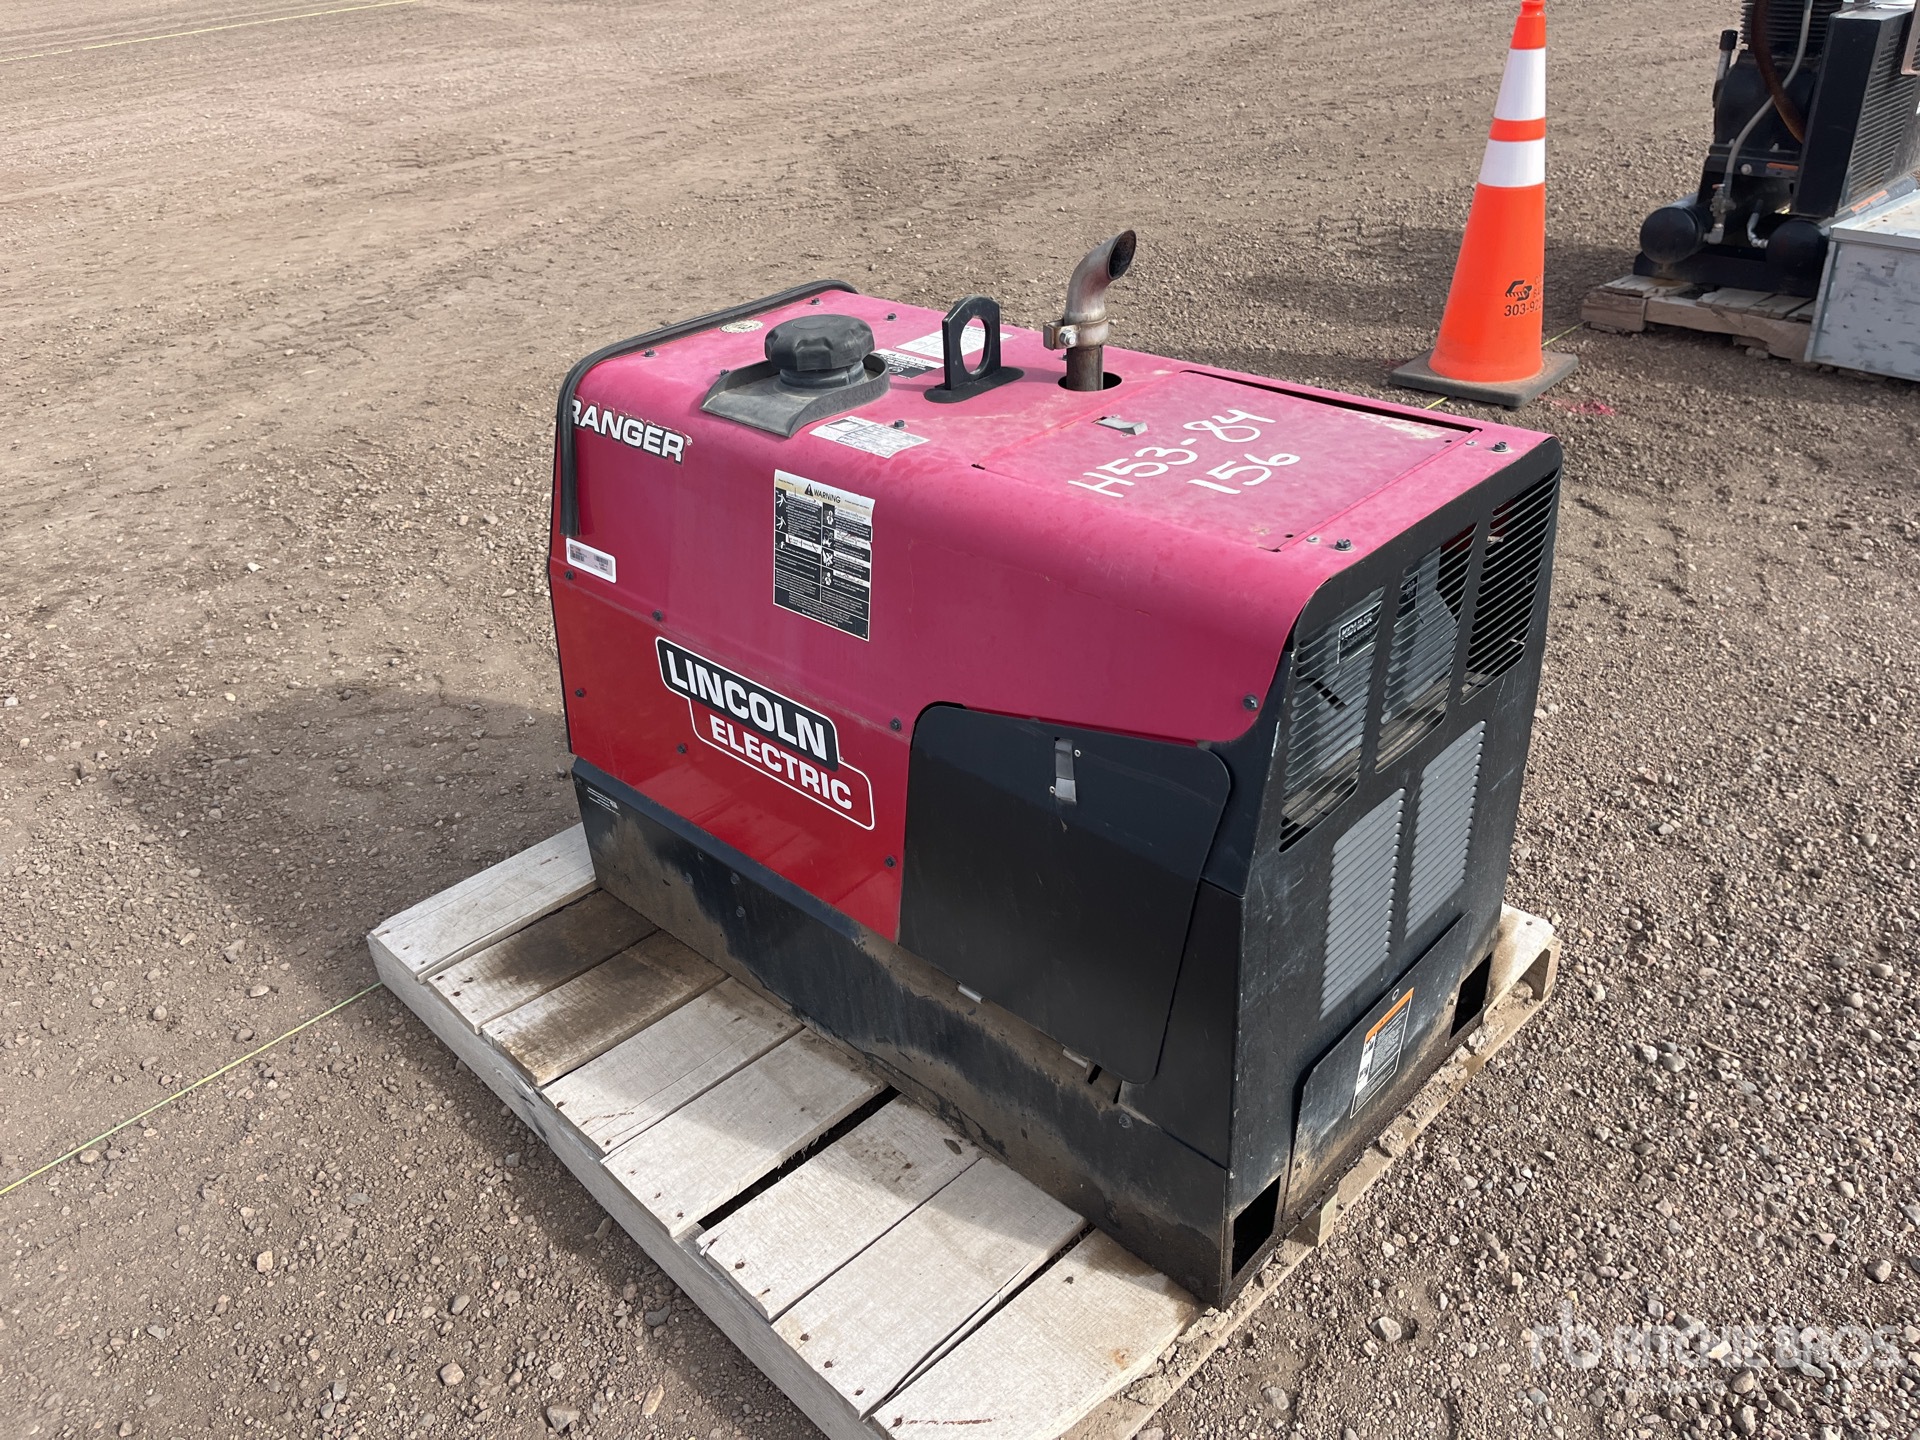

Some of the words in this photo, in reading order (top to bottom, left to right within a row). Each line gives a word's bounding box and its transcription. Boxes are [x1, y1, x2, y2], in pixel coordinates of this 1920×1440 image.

[813, 488, 841, 504] WARNING
[1067, 409, 1277, 498] H53-84
[1186, 453, 1301, 495] 156
[666, 650, 828, 762] LINCOLN
[709, 713, 853, 810] ELECTRIC
